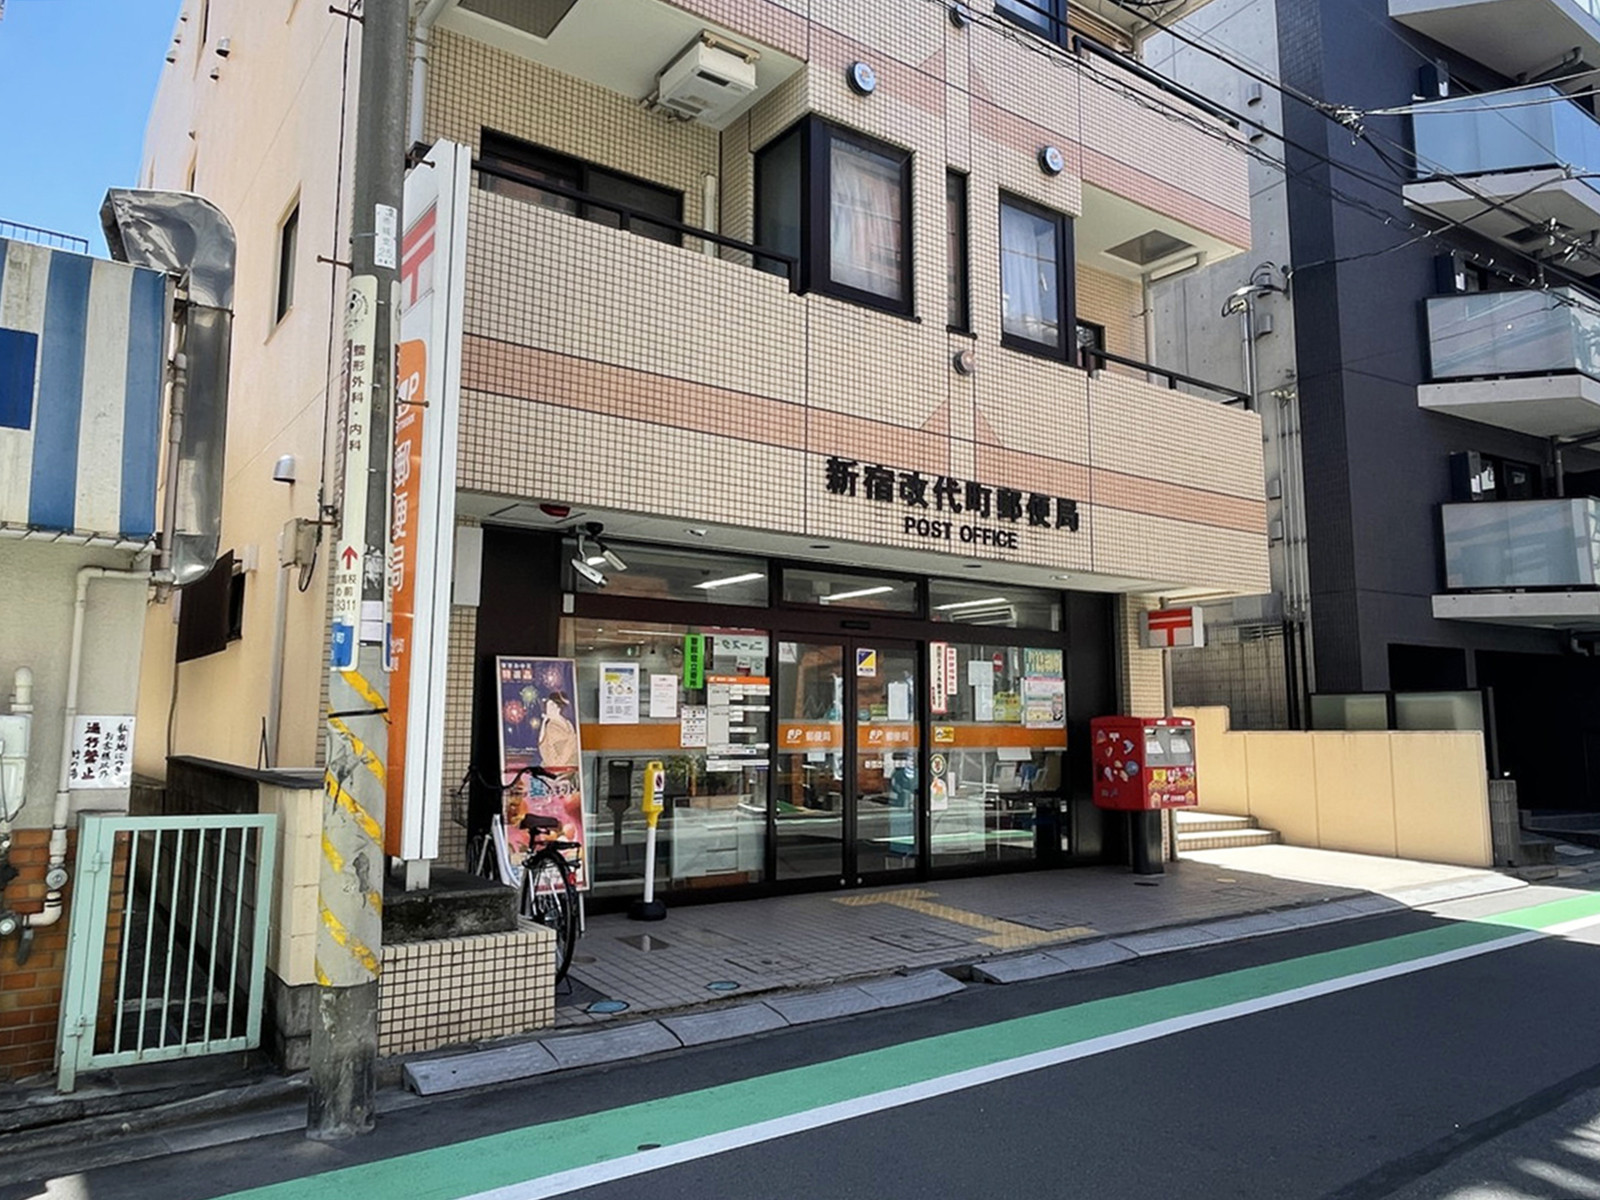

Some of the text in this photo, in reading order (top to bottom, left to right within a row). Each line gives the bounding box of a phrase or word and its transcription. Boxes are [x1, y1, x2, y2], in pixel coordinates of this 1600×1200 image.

[348, 344, 366, 452] 整形外科・内科
[825, 456, 1079, 532] 新宿改代町郵便局
[904, 516, 1019, 549] POST OFFICE
[81, 722, 101, 780] 通行禁止
